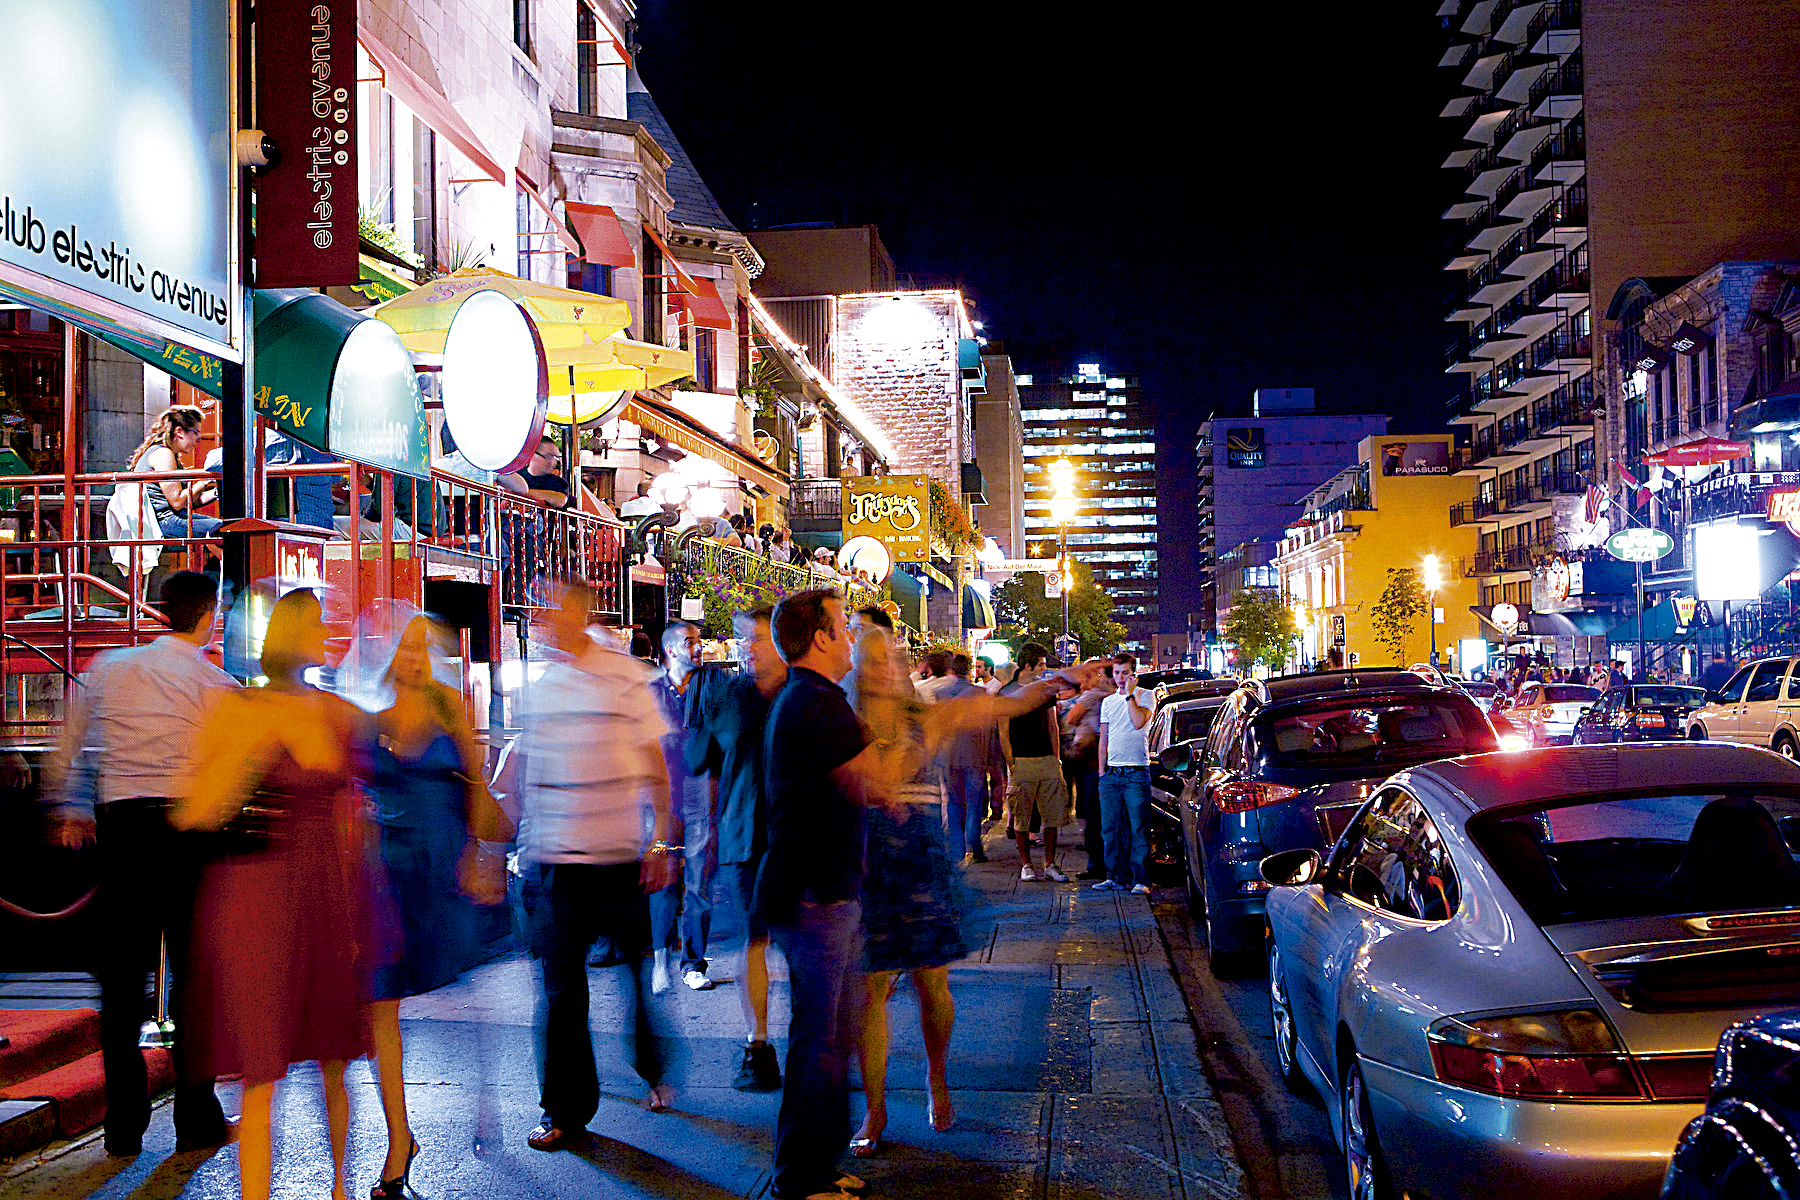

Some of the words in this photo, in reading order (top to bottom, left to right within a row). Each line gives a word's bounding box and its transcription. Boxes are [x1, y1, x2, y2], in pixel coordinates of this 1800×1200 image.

[311, 4, 331, 118] avenue
[306, 126, 333, 249] electric
[53, 225, 146, 293] electric
[151, 270, 227, 326] avenue
[1230, 451, 1264, 461] QUALITY
